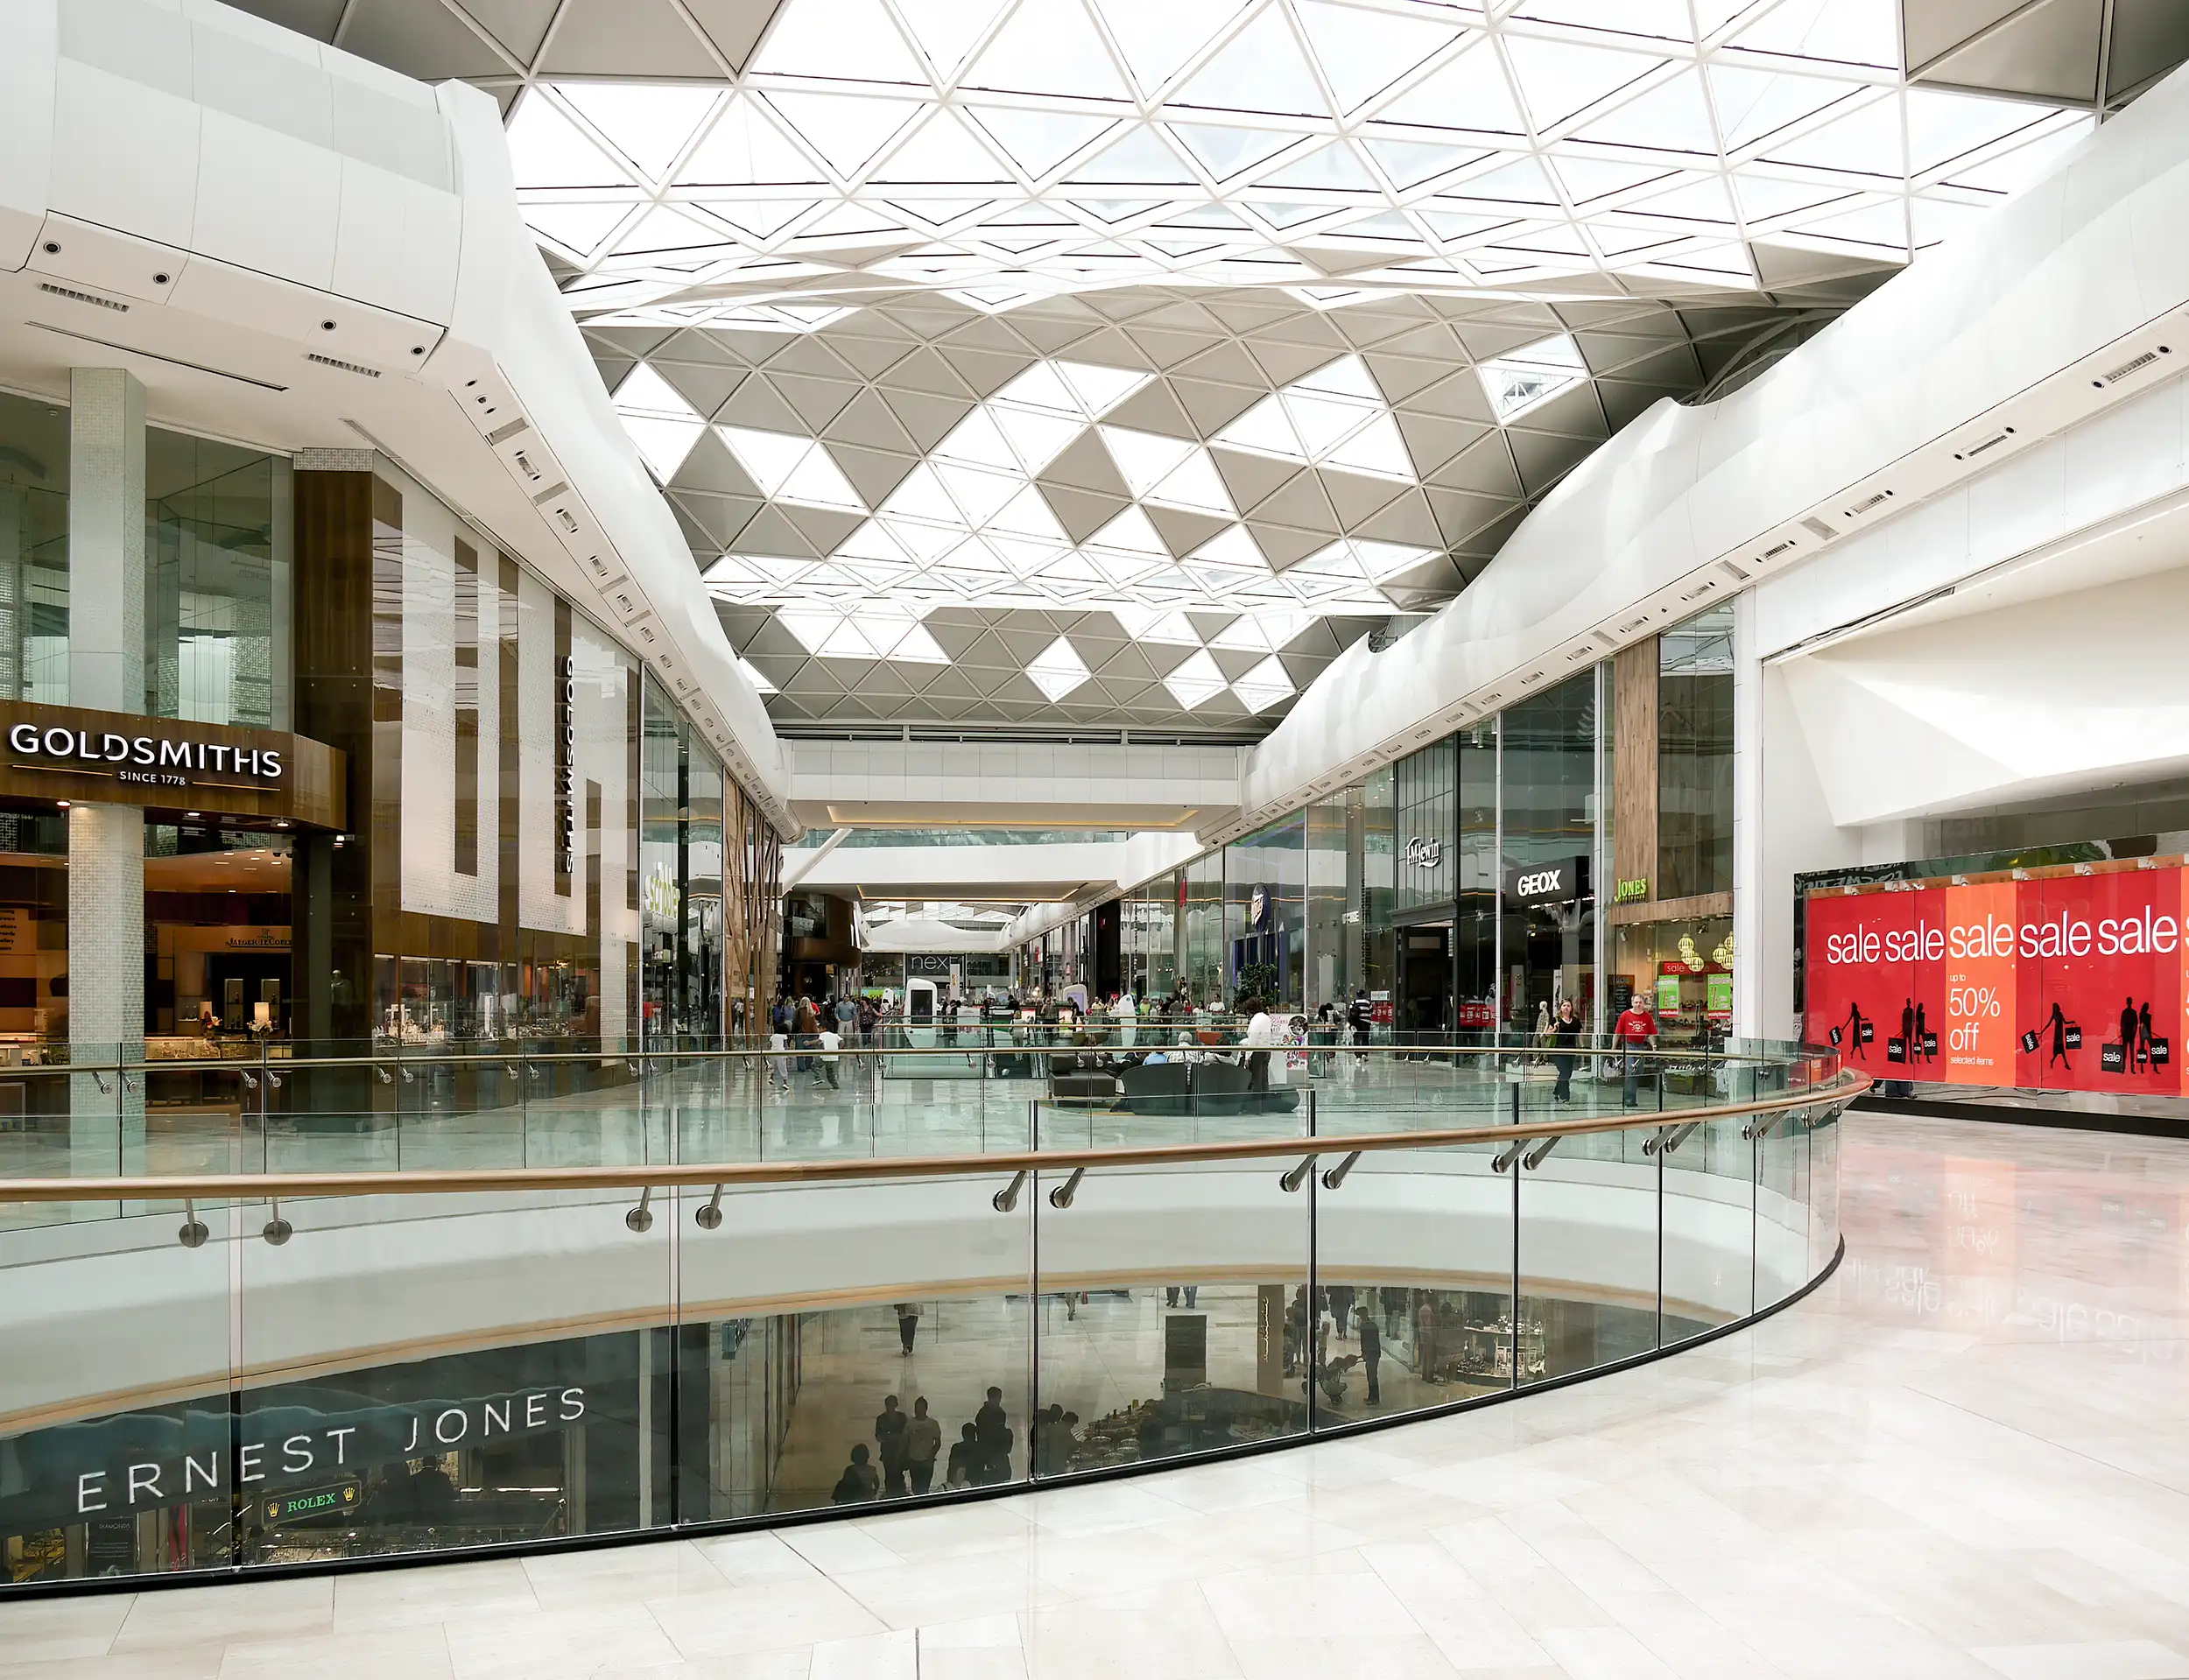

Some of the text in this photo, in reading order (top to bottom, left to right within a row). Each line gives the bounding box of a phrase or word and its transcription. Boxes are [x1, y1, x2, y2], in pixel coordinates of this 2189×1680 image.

[11, 724, 283, 777] GOLDSMITHS
[566, 655, 574, 874] GOLDSMITHS
[120, 770, 187, 786] SINCE 1778
[1517, 869, 1561, 896] GEOX
[1614, 879, 1648, 902] JONES
[1827, 923, 1881, 964] sale
[1885, 919, 1945, 961] sale
[1949, 914, 2014, 958] sale
[2019, 910, 2092, 959] sale
[2097, 905, 2178, 955] sale
[1666, 964, 1685, 973] sale
[1949, 986, 2001, 1017] 50%
[1862, 1028, 1873, 1037] sale
[1949, 1022, 1980, 1051] off
[2066, 1033, 2080, 1043] sale
[1889, 1044, 1902, 1054] sale
[1925, 1038, 1936, 1048] sale
[2151, 1044, 2167, 1055] sale
[1950, 1056, 1994, 1065] selected items
[2102, 1051, 2121, 1063] sale
[77, 1388, 586, 1514] ERNEST JONES
[287, 1493, 336, 1512] ROLEX
